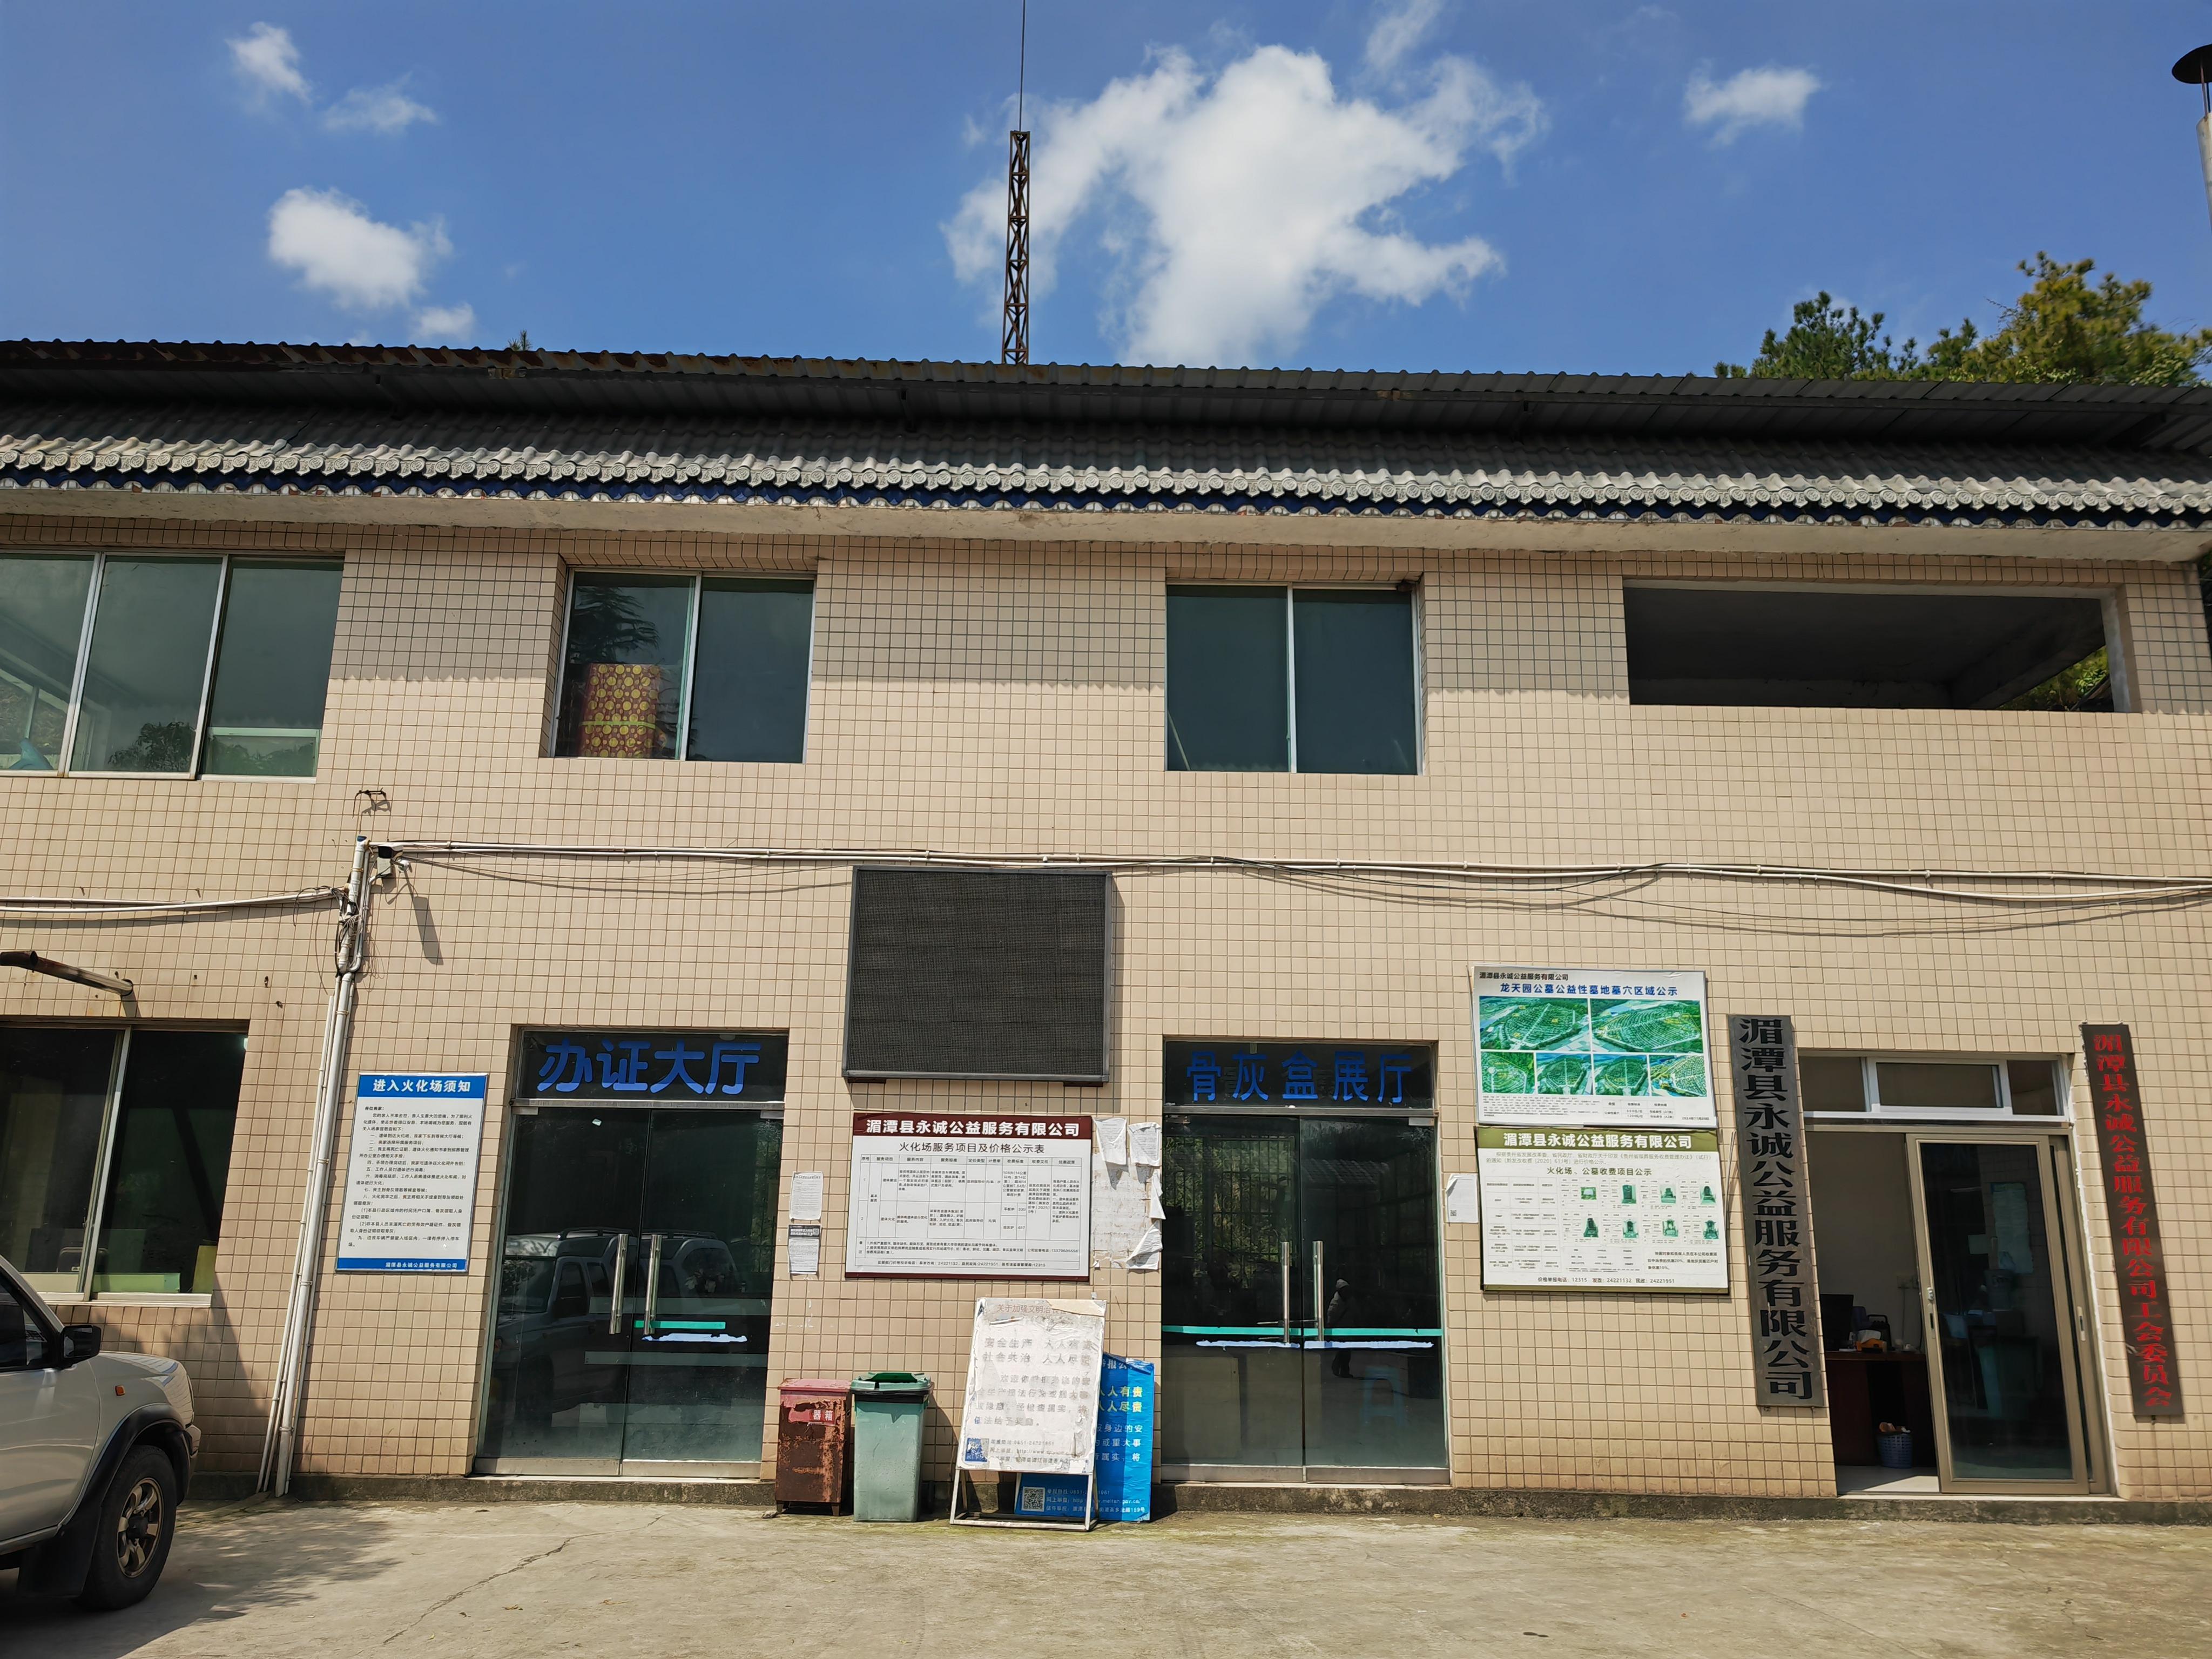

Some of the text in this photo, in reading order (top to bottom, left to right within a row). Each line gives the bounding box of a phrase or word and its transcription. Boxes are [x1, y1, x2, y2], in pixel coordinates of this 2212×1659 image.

[1479, 972, 1569, 981] 湄潭县永诚公益服务有限公司
[1500, 982, 1678, 996] 龙天园公墓公益性墓地墓穴区域公示
[537, 1037, 762, 1095] 办证大厅
[1187, 1050, 1412, 1104] 骨灰盒展厅
[373, 1079, 471, 1092] 进入火化场须知
[866, 1120, 1080, 1137] 湄潭县永诚公益服务有限公司
[1503, 1132, 1692, 1149] 湄潭县永诚公益服务有限公司
[899, 1142, 1046, 1154] 火化场服务项目及价格公示表
[1547, 1166, 1653, 1176] 火化场、公墓收费项目公示
[1738, 1018, 1813, 1400] 湄潭县永诚公益服务有限公司
[2093, 1034, 2173, 1407] 湄潭县永诚公益服务有限公司工会委员会
[1102, 1359, 1133, 1370] 报公
[813, 1409, 834, 1421] 器箱
